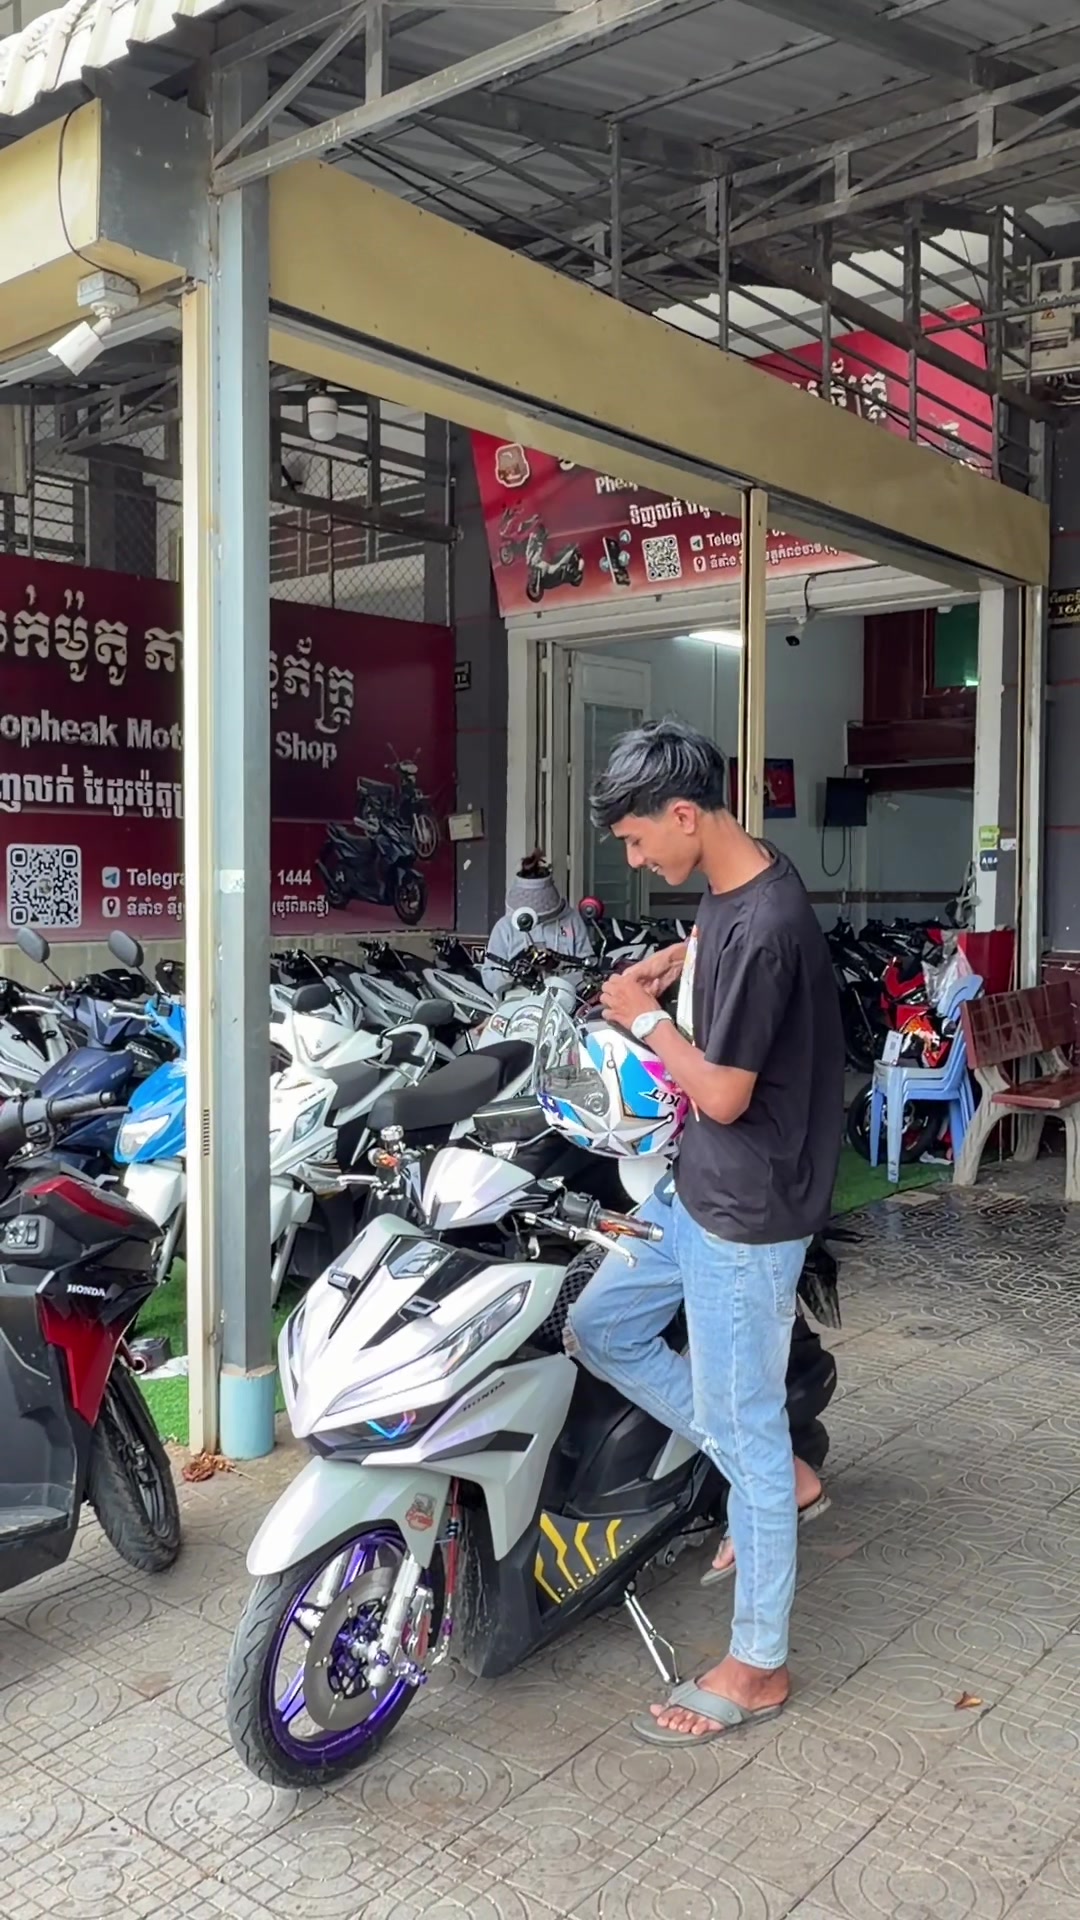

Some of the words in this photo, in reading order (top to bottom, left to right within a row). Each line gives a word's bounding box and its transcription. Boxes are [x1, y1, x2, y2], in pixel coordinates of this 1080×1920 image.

[706, 532, 742, 548] Teleg
[0, 584, 129, 686] ក់ម៉ូតូ
[0, 709, 119, 749] opheak
[127, 717, 184, 750] Mot
[275, 731, 337, 769] Shop
[277, 869, 312, 886] 1444
[67, 1284, 106, 1297] HONDA
